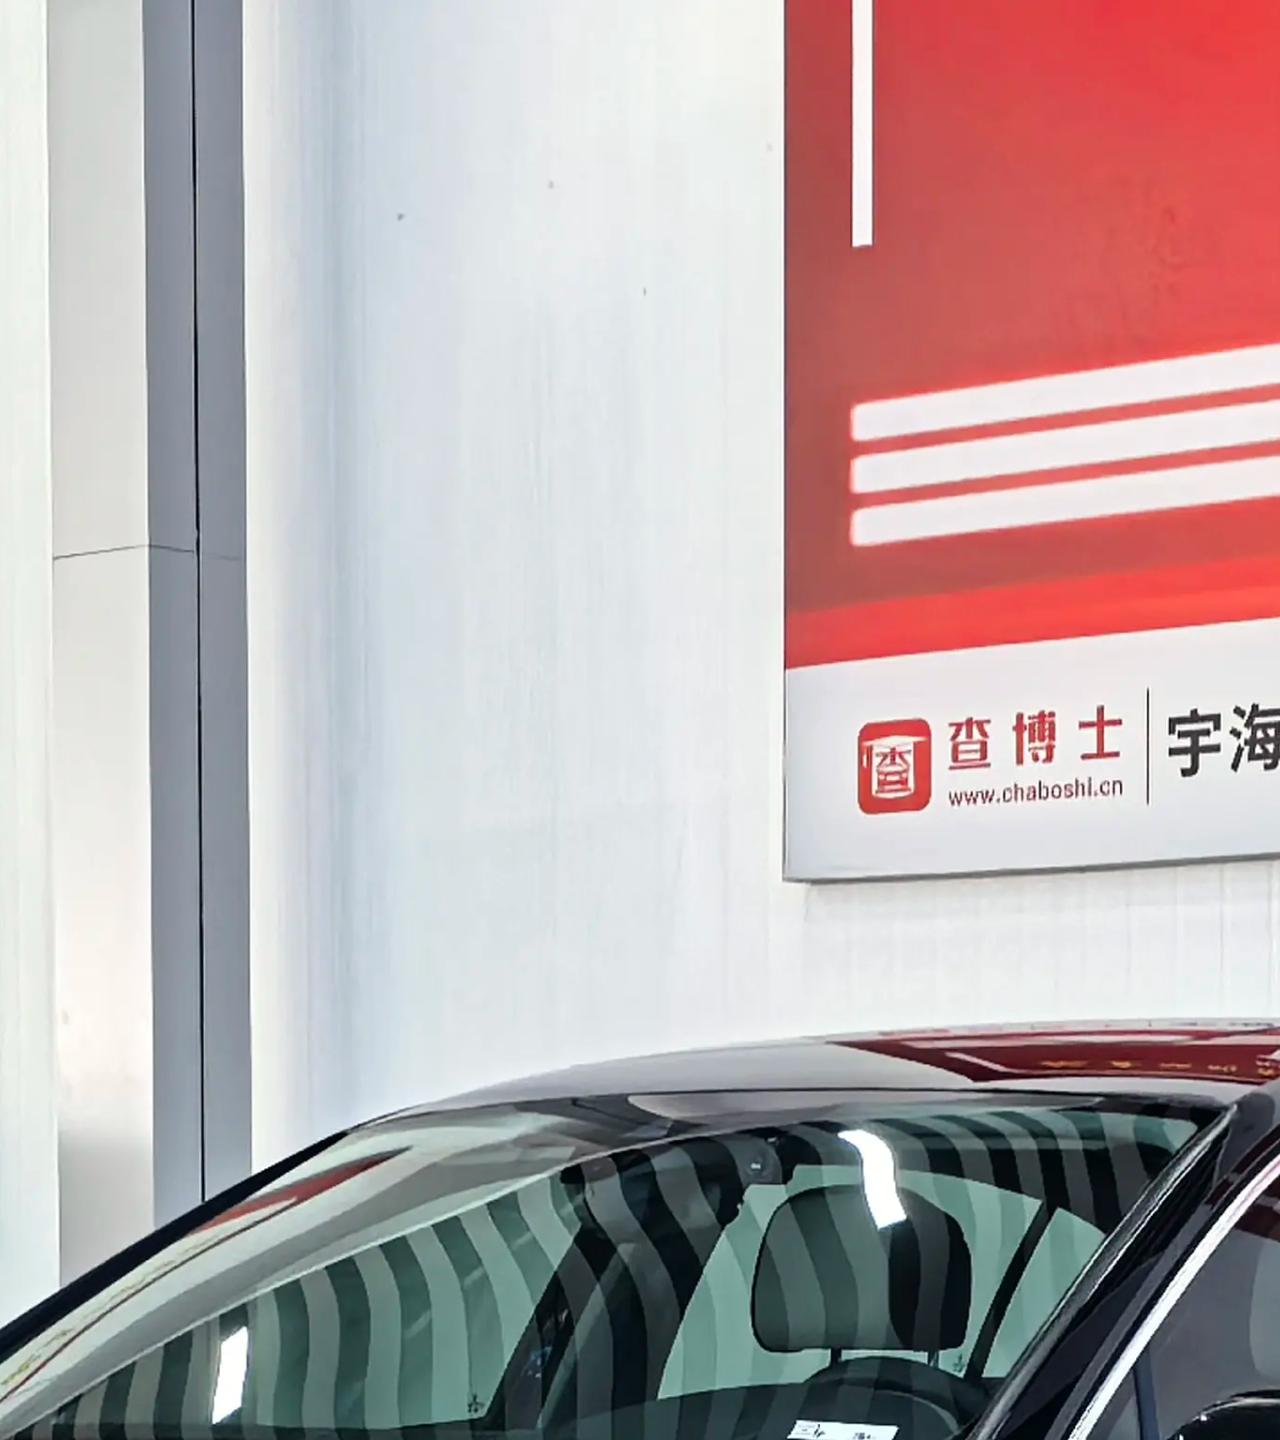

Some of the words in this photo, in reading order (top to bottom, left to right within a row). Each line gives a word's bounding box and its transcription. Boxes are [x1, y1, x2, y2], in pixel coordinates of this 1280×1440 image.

[948, 704, 1123, 770] 查博士
[948, 776, 1124, 806] www.chaboshi.cn
